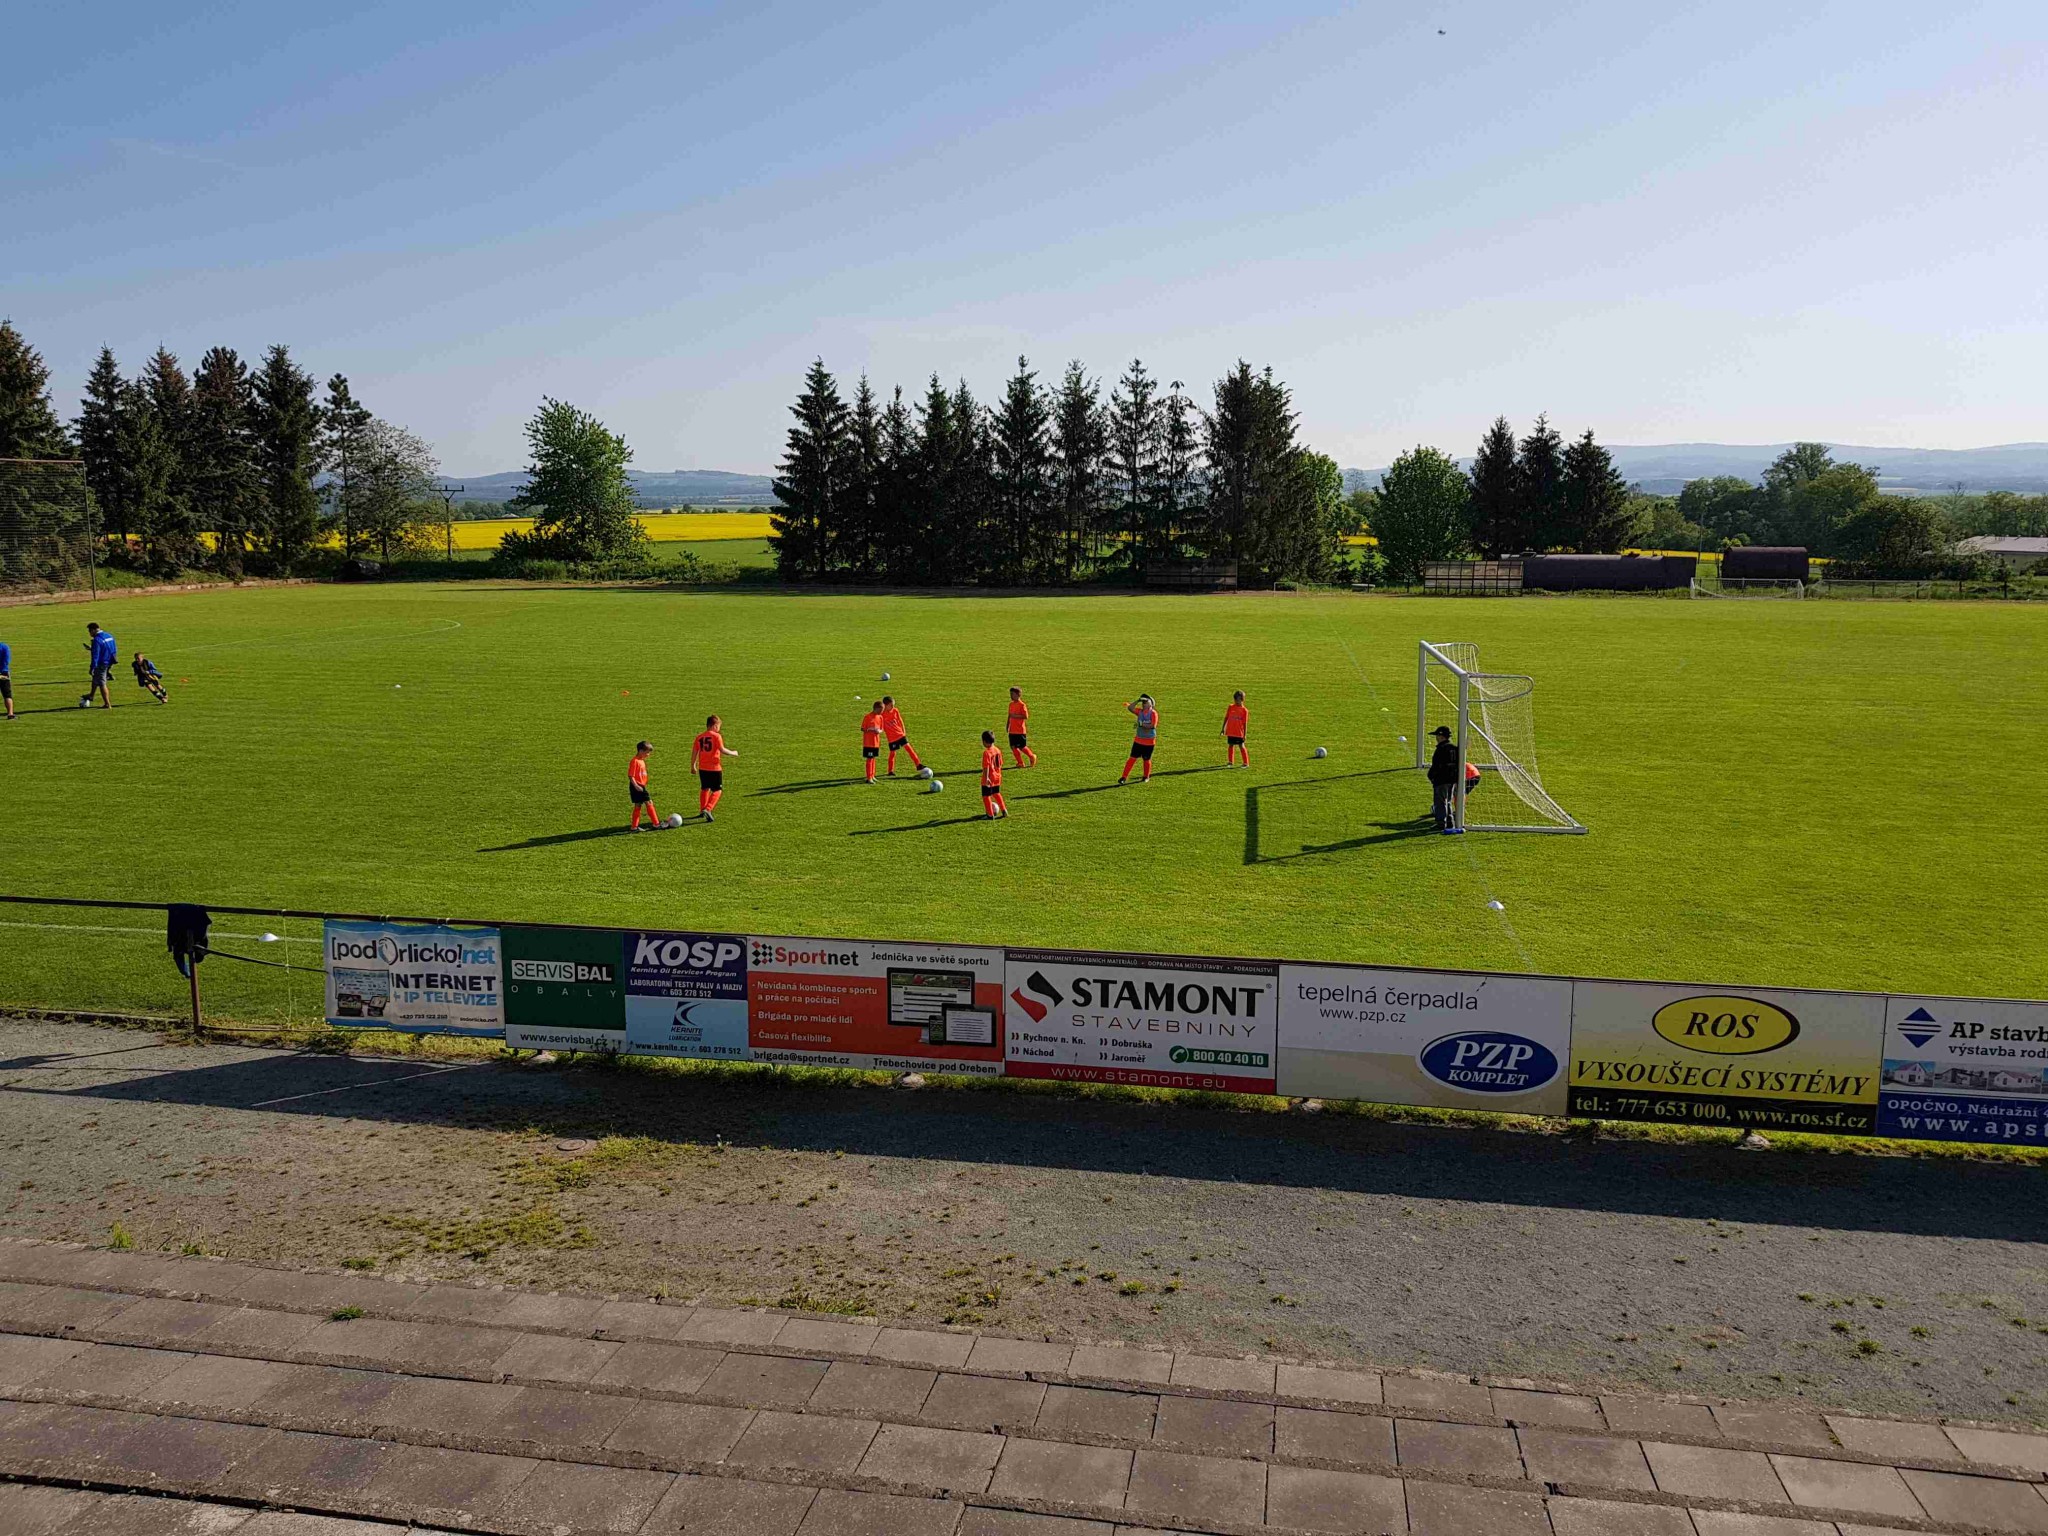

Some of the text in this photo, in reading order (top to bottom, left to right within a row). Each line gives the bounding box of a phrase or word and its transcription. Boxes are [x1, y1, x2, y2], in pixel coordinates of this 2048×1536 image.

[699, 737, 713, 752] 15
[633, 938, 741, 968] KOSP
[775, 946, 859, 967] Sportnet
[871, 951, 990, 966] Jednička ve světě sportu
[513, 962, 612, 982] SERVISBAL
[630, 966, 658, 974] Kernite
[705, 969, 737, 978] Program
[390, 972, 496, 991] INTERNET
[630, 978, 673, 988] LABORATORNÍ
[674, 981, 694, 989] TESTY
[696, 981, 714, 989] PALIV
[722, 983, 743, 991] MAZIV
[757, 981, 878, 995] Nevidaná kombinace sportu
[404, 991, 420, 1003] IP
[423, 991, 498, 1006] TELEVIZE
[669, 988, 712, 998] 603 278 512
[765, 992, 790, 1002] práce
[791, 995, 803, 1003] na
[1071, 977, 1264, 1018] STAMONT
[1298, 982, 1478, 1011] tepelná čerpadla
[758, 1010, 792, 1021] Brigáda
[793, 1015, 808, 1023] pro
[810, 1014, 837, 1023] mladé
[1319, 1007, 1407, 1024] www.pzp.cz
[670, 1026, 704, 1035] KERNITE
[1072, 1014, 1257, 1038] STAVEBNINY
[1683, 1011, 1760, 1039] ROS
[1949, 1021, 1984, 1039] AP
[520, 1033, 608, 1047] www.servisbal.cz
[758, 1028, 832, 1043] Časová flexibilita
[1023, 1033, 1086, 1045] Rychnov n. Kn.
[713, 1045, 727, 1054] 278
[728, 1046, 742, 1055] 512
[1111, 1038, 1153, 1049] Dobruška
[1948, 1043, 2048, 1059] výstavba rod
[754, 1050, 850, 1065] brigada@sportnet.cz
[1023, 1047, 1055, 1057] Náchod
[1111, 1052, 1147, 1063] Jaroměř
[1193, 1050, 1264, 1065] 800 40 40 10
[1450, 1039, 1534, 1071] PZP
[873, 1057, 997, 1074] Třebechovice pod Orebem
[1051, 1067, 1226, 1089] www.stamont.eu
[1447, 1069, 1529, 1086] KOMPLET
[1577, 1060, 1870, 1096] VYSOUŠECÍ SYSTÉMY
[1576, 1096, 1867, 1128] tel.: 777 653 000, www.ros.sf.cz
[1887, 1099, 1962, 1115] OPOČNO,
[1967, 1103, 2038, 1117] Nádražní
